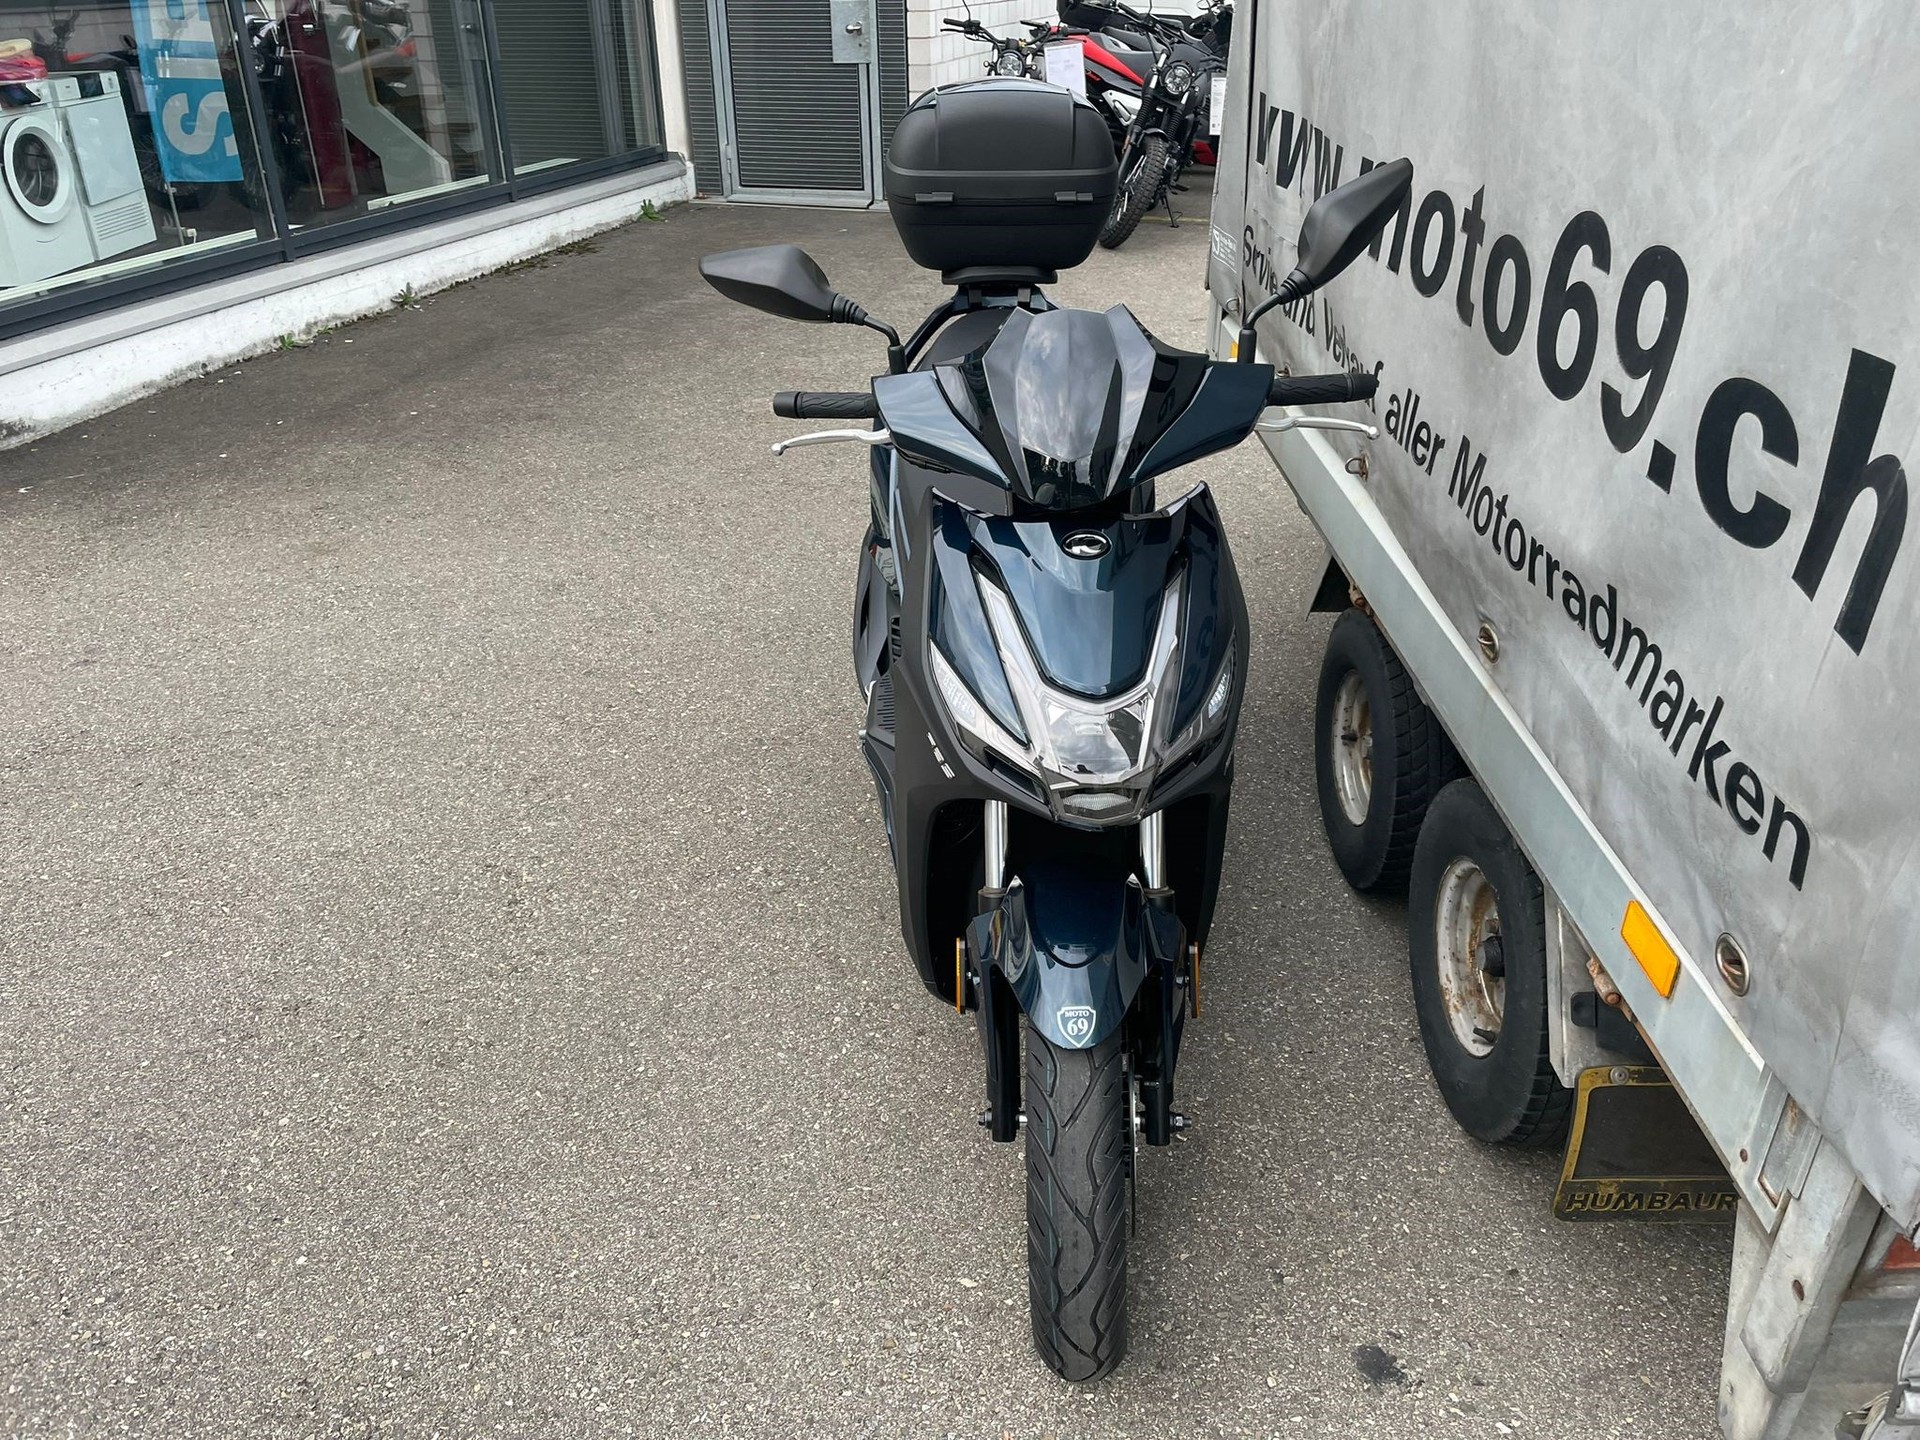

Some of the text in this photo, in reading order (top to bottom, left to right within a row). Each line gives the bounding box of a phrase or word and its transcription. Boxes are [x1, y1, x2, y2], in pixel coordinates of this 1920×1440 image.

[1256, 91, 1908, 656] wwwmoto69.ch
[1385, 388, 1445, 476] aller
[1448, 435, 1811, 892] Motorradmarken
[1064, 1010, 1090, 1018] MOTO
[1067, 1018, 1089, 1036] 69
[1565, 1191, 1738, 1212] HUMBAUR
